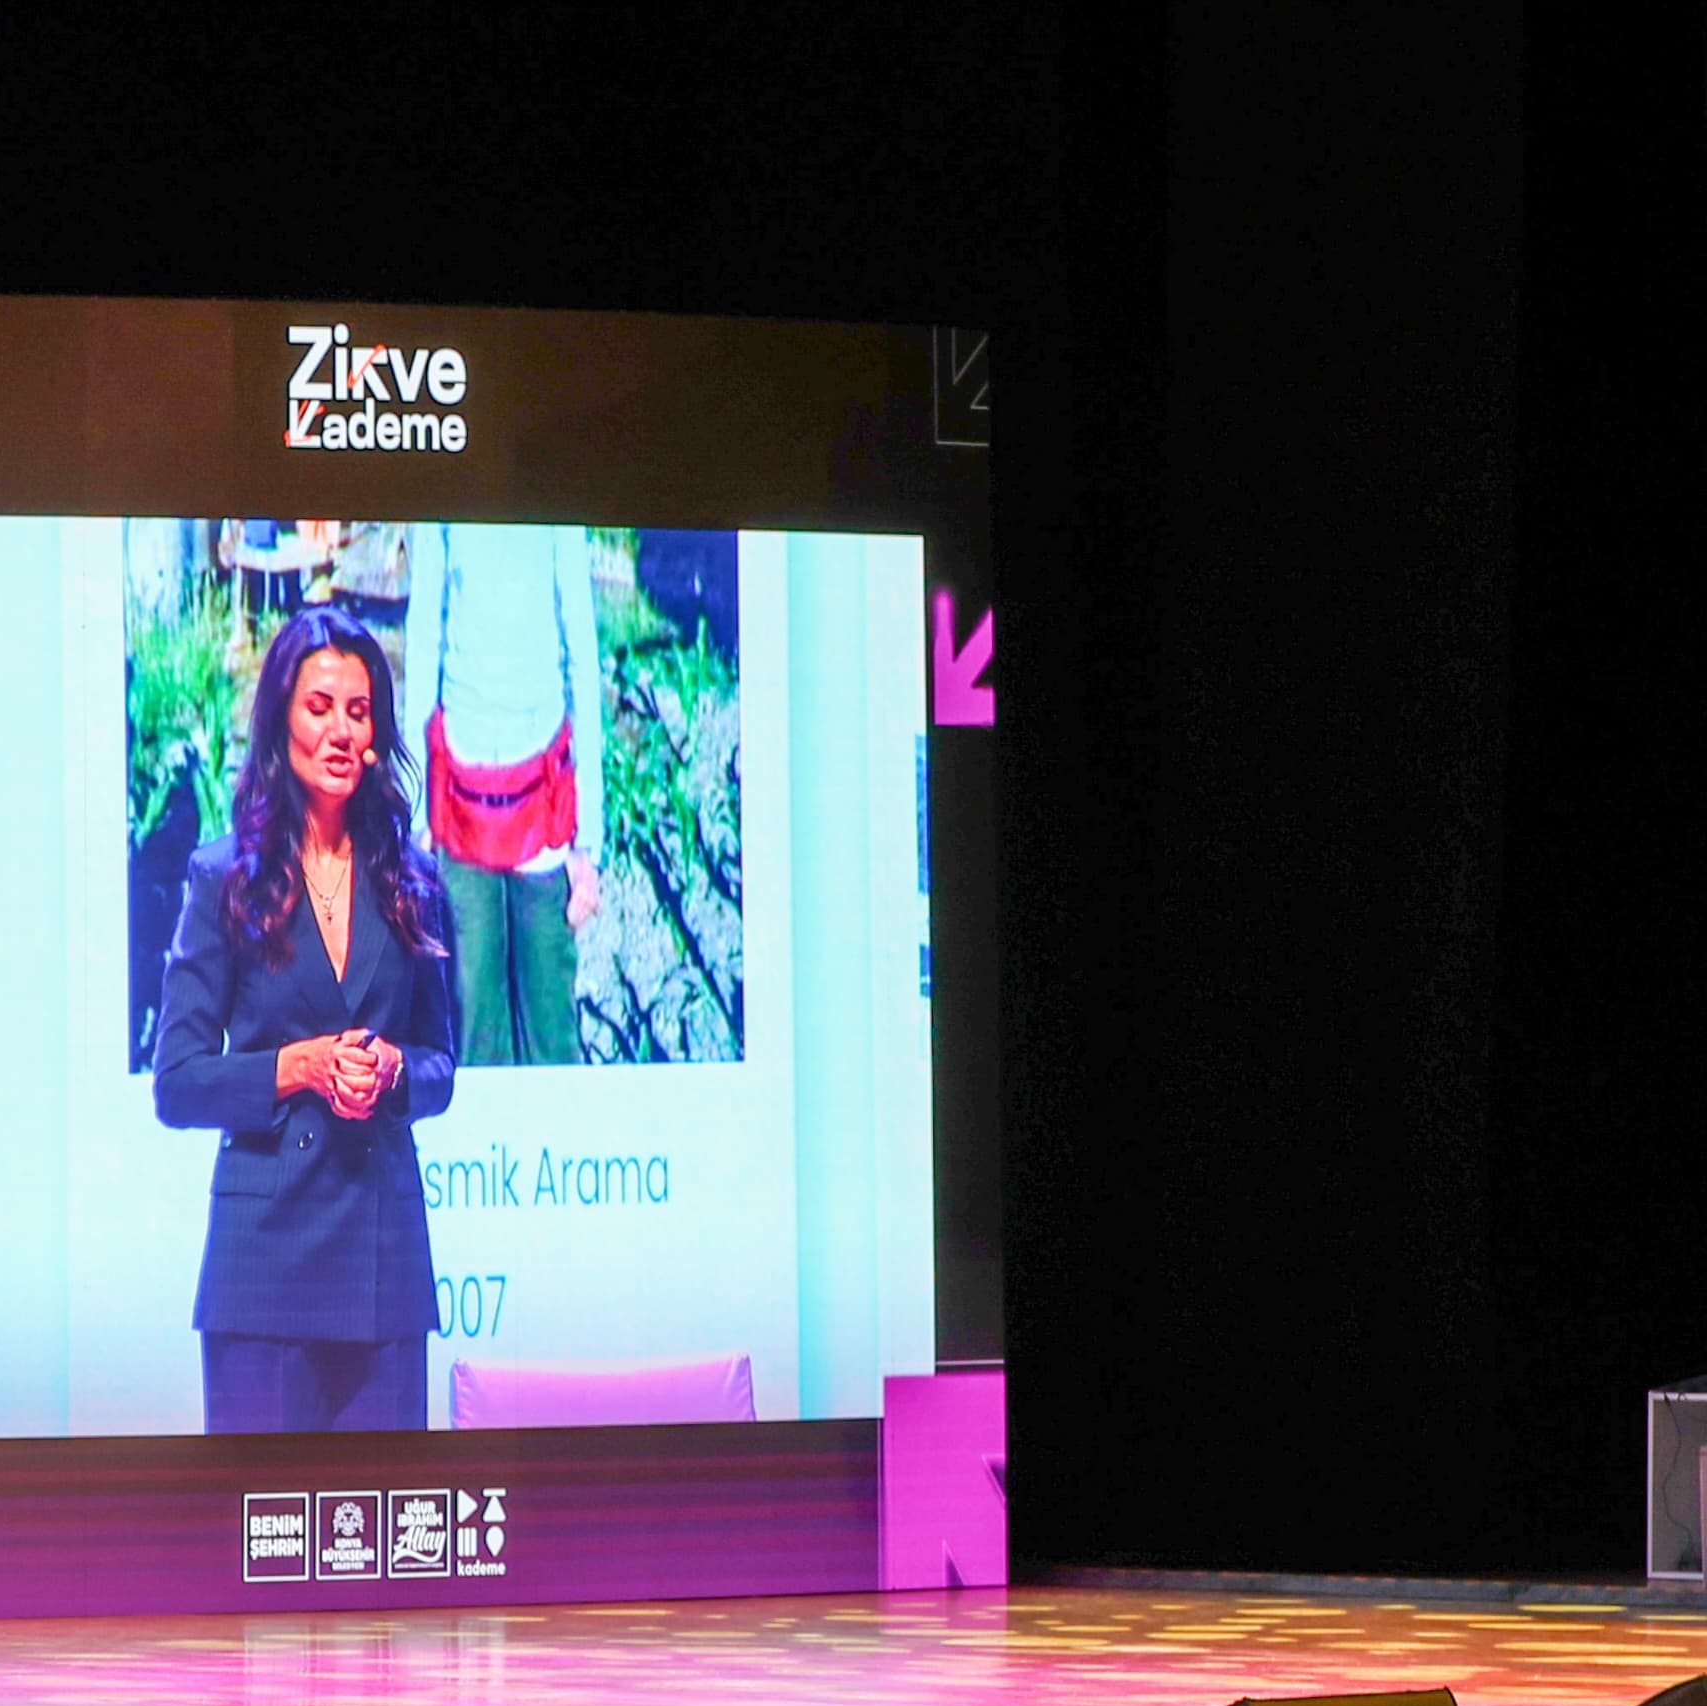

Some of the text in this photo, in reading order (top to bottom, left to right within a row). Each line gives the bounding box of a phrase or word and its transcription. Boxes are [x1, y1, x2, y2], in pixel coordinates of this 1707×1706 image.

[423, 1143, 669, 1209] smik Arama
[435, 1275, 507, 1339] 007
[249, 1514, 304, 1538] BENİM
[249, 1536, 304, 1561] ŞEHRİM
[456, 1560, 507, 1577] kademe
